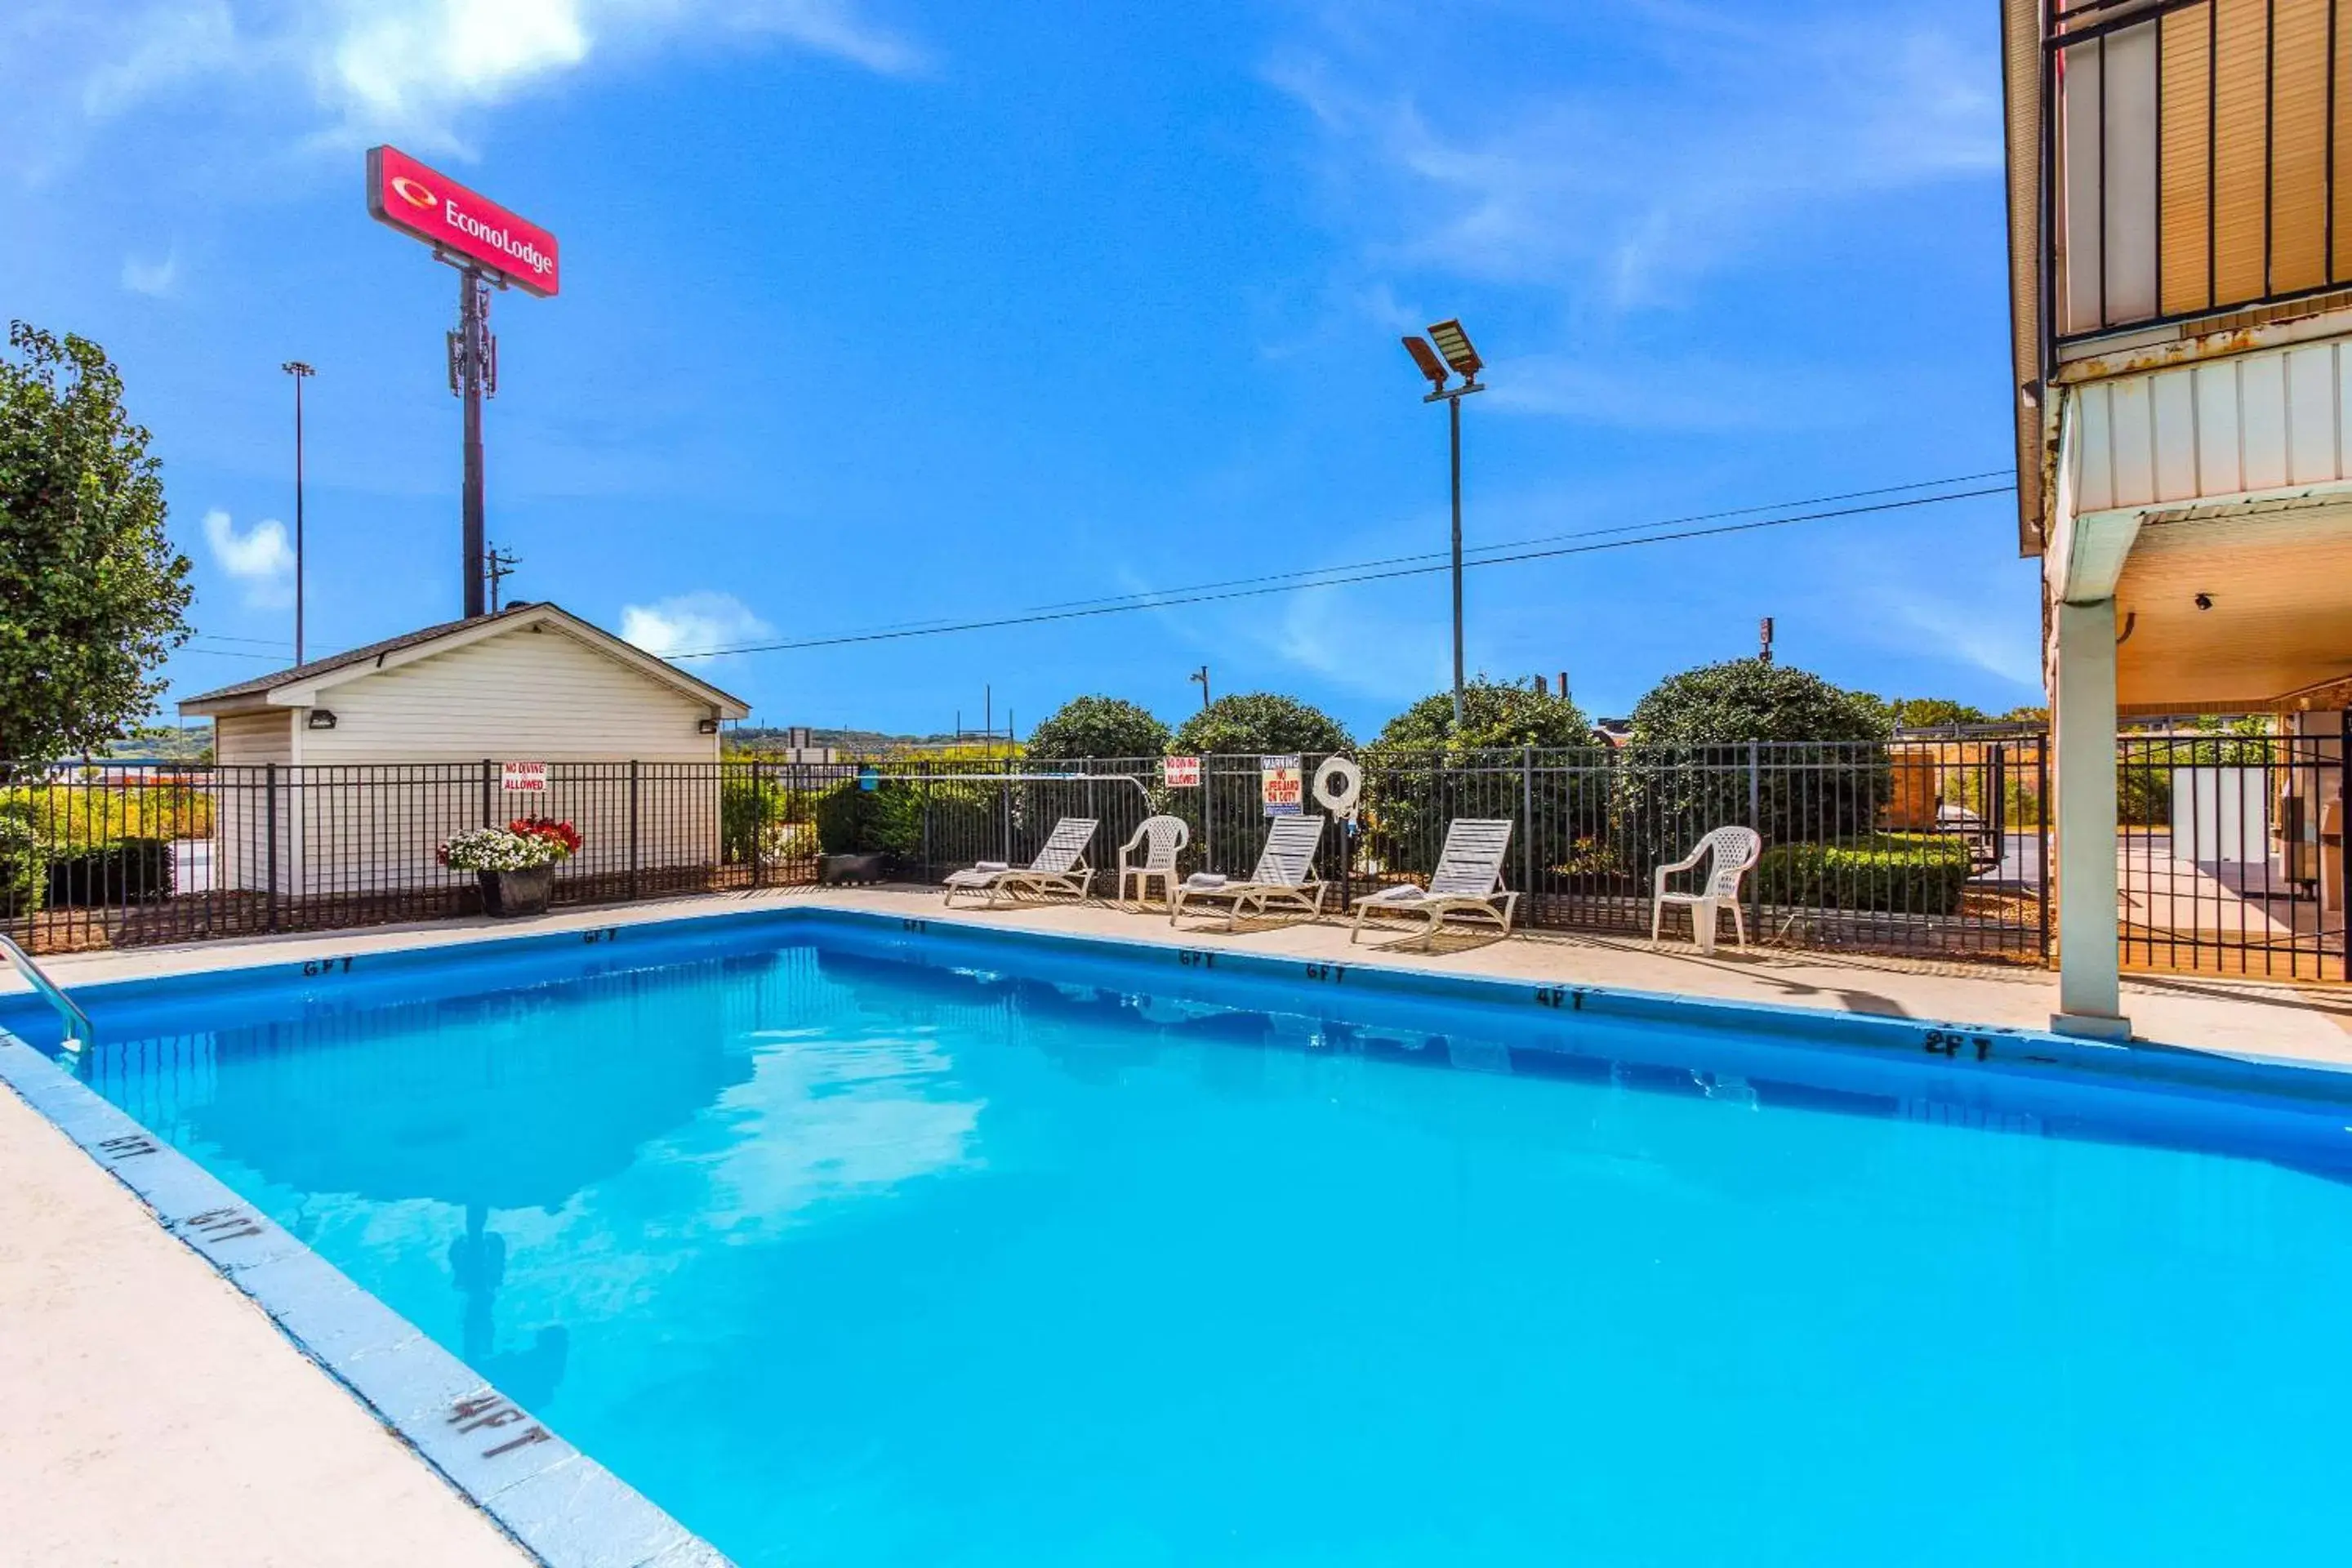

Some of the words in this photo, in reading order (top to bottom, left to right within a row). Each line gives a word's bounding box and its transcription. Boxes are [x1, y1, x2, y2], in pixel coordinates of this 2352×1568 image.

[445, 199, 553, 274] EconoLodge
[506, 763, 516, 773] NO
[519, 762, 545, 773] DIVING
[505, 779, 543, 790] ALLOWED
[1925, 1031, 1992, 1062] 2FT
[447, 1395, 552, 1459] 4FT
